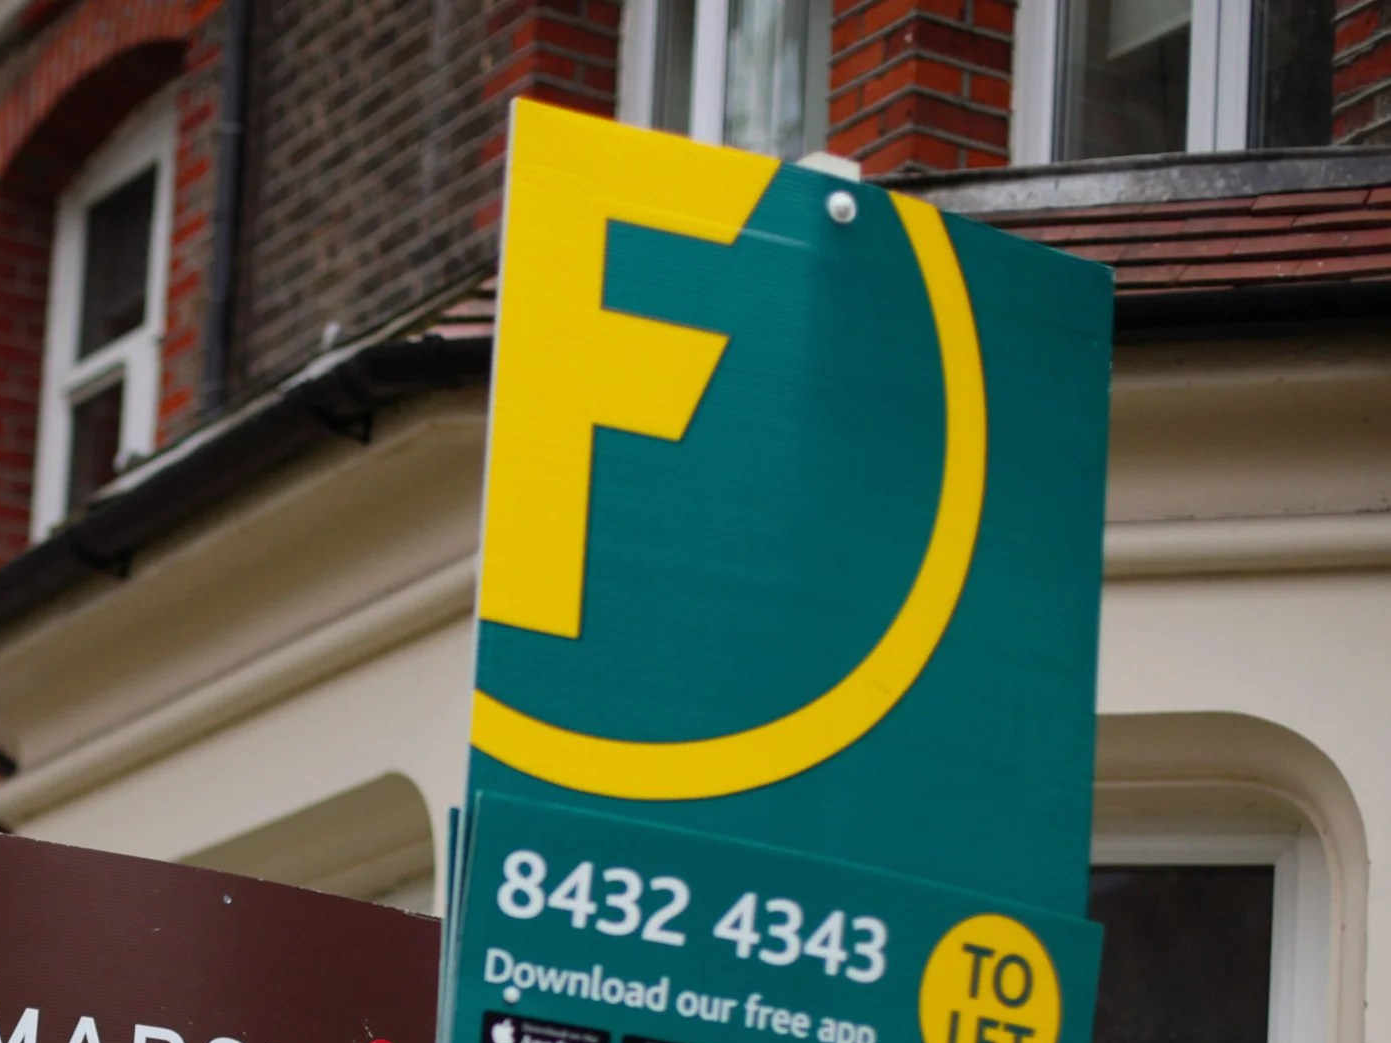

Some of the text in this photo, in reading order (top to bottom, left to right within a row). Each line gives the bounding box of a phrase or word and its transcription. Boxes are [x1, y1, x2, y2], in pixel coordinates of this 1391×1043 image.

[496, 849, 887, 983] 8432 4343
[484, 948, 670, 1012] Download
[676, 989, 736, 1024] our
[744, 993, 809, 1040] free
[962, 942, 1033, 1009] TO
